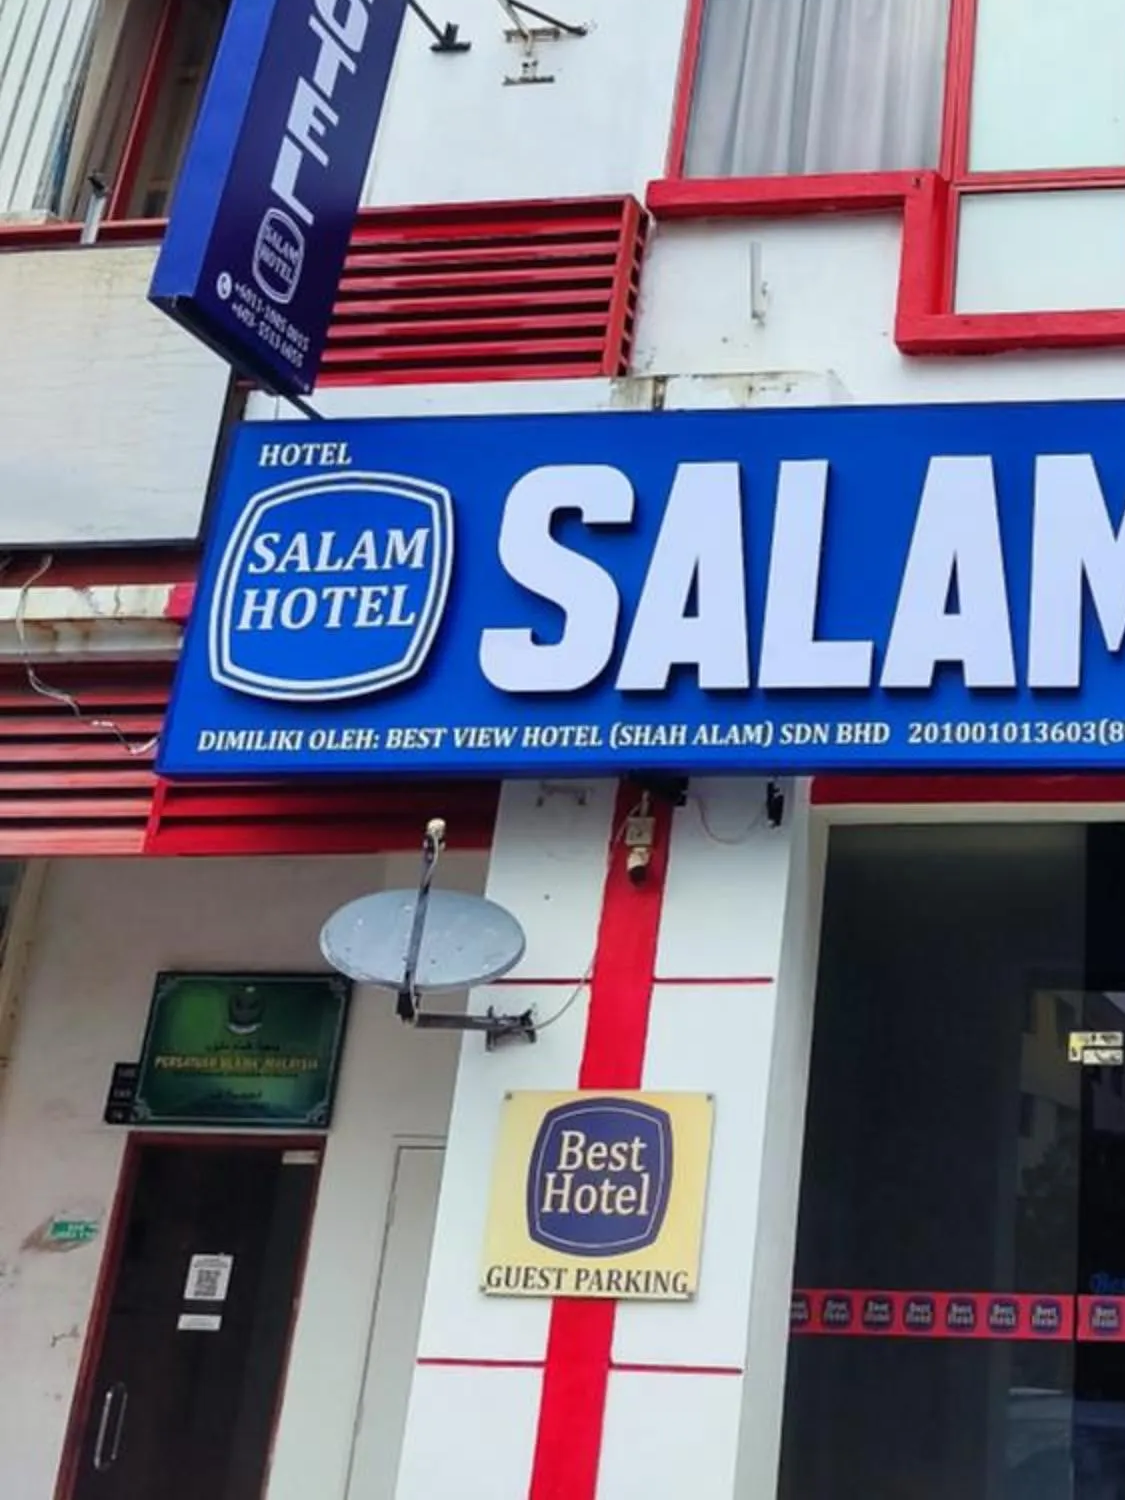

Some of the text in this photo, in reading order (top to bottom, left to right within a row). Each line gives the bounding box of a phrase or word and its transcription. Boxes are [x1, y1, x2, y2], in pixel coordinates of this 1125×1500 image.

[258, 442, 352, 467] HOTEL
[247, 527, 430, 575] SALAM
[236, 584, 417, 631] HOTEL
[197, 730, 302, 751] DIMILIKI
[308, 729, 378, 750] OLEH:
[385, 728, 447, 749] BEST
[453, 727, 518, 748] VIEW
[521, 726, 602, 747] HOTEL
[609, 723, 688, 748] (SHAH
[692, 722, 773, 746] ALAM)
[779, 723, 830, 745] SDN
[836, 723, 890, 744] BHD
[557, 1130, 647, 1172] Best
[540, 1172, 649, 1216] Hotel
[486, 1265, 689, 1294] GUEST PARKING
